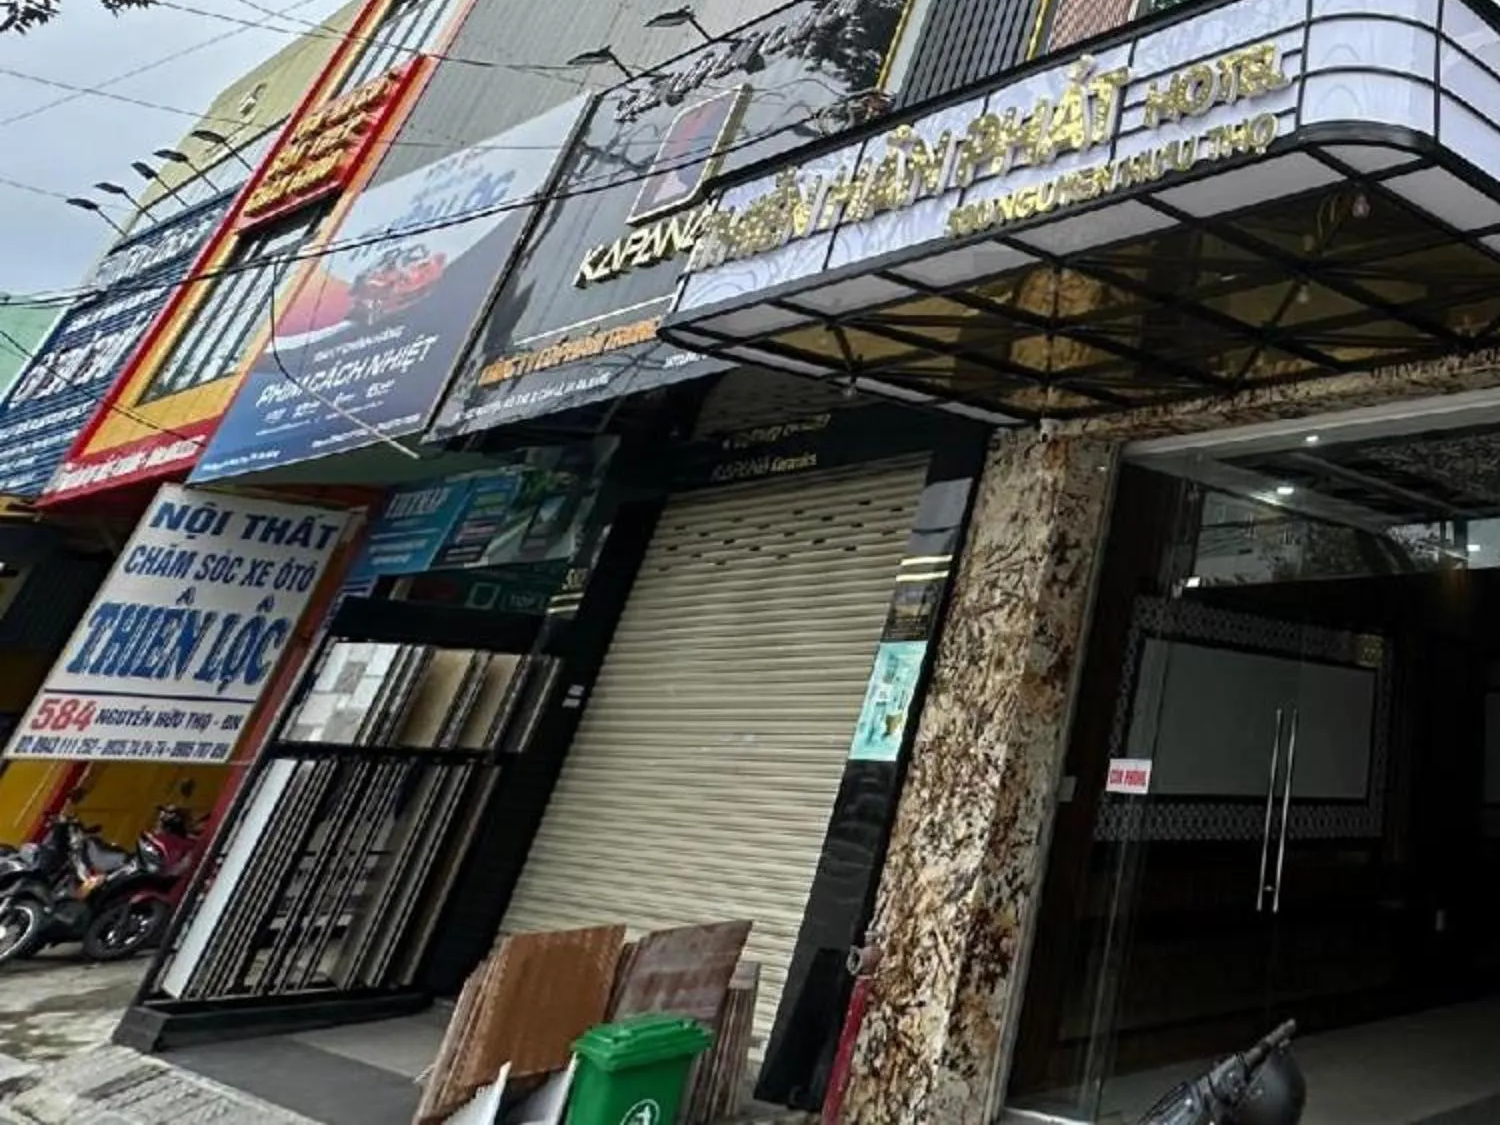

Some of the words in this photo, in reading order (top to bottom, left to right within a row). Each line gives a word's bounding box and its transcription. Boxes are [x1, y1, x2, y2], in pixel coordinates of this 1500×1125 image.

[953, 55, 1130, 188] PHÁT
[1142, 41, 1292, 129] HOTEL
[149, 501, 235, 540] NỘI
[240, 513, 338, 551] THẤT
[123, 542, 198, 581] CHĂM
[194, 548, 244, 585] SÓC
[240, 554, 275, 591] XE
[193, 594, 293, 695] LỘC
[31, 698, 97, 732] 584
